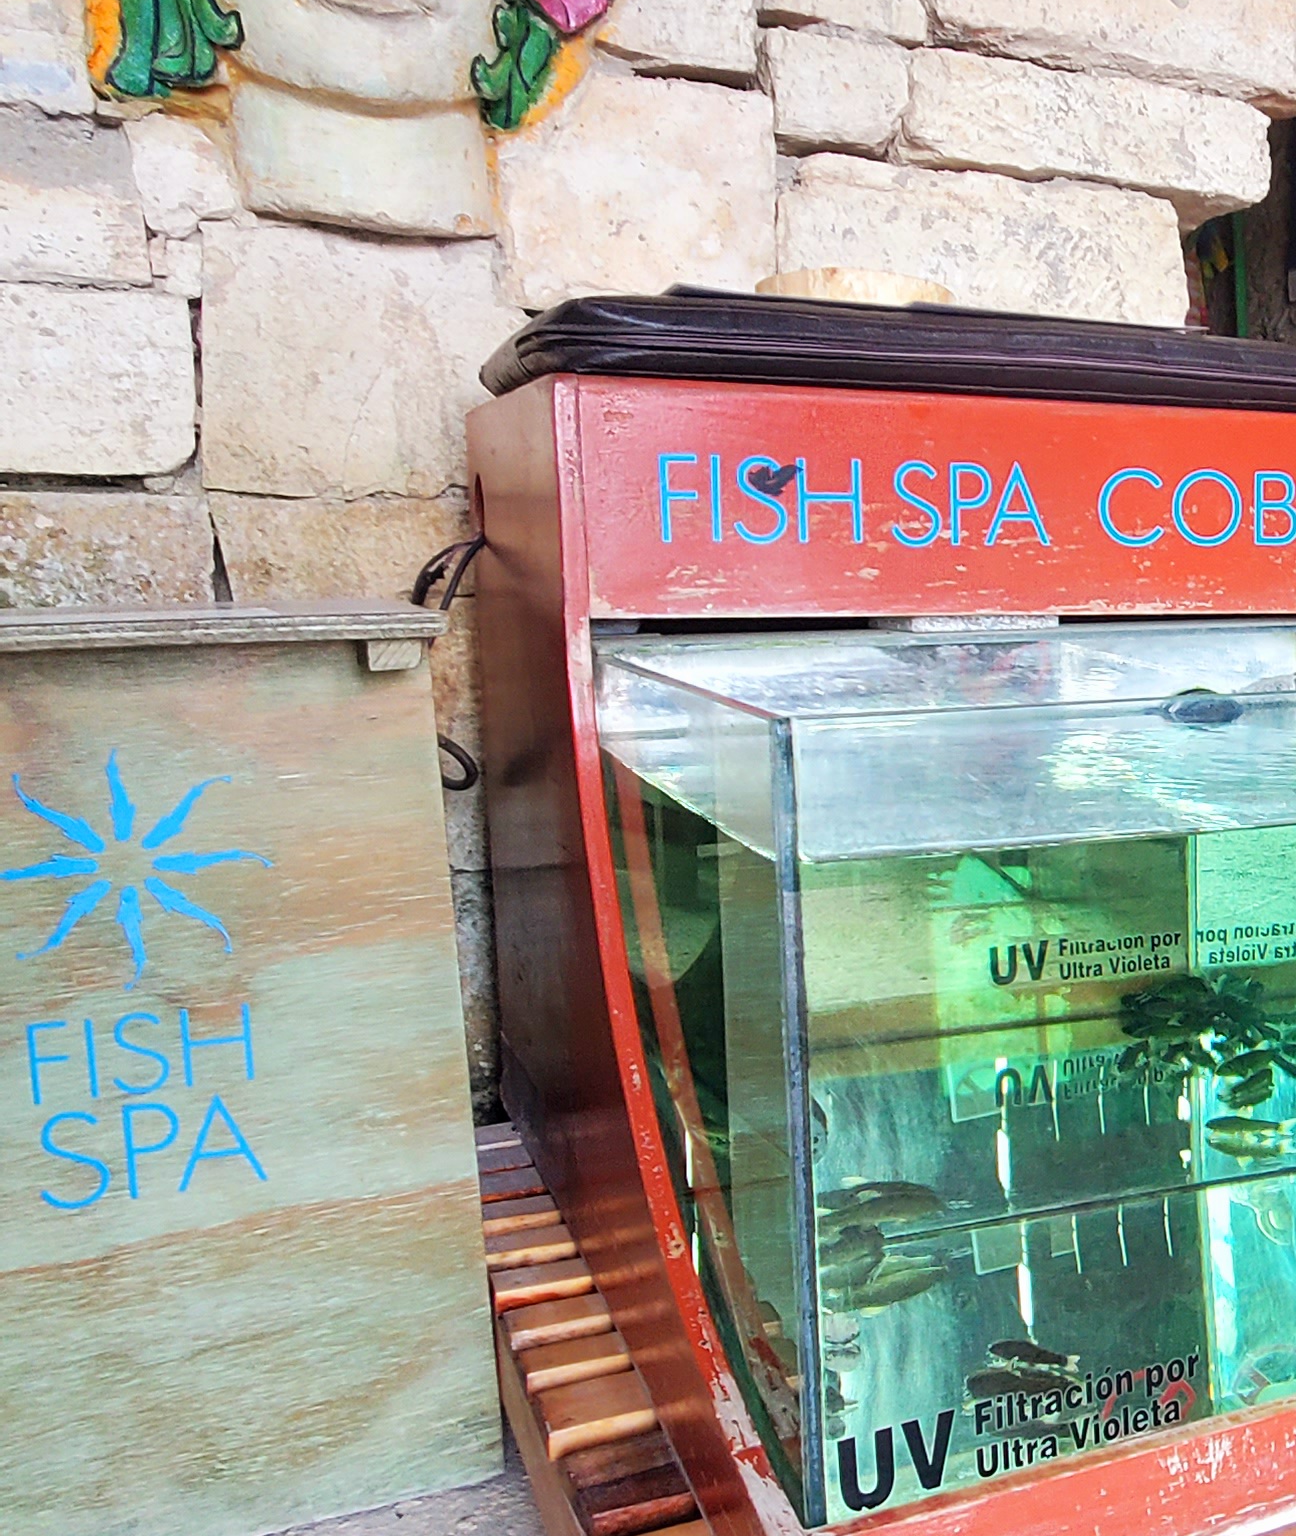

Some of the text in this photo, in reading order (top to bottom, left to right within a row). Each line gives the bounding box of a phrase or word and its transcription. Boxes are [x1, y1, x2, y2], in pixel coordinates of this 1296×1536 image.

[657, 452, 864, 545] FISH
[891, 460, 1051, 547] SPA
[989, 939, 1049, 986] UV
[1059, 954, 1171, 980] Ultra Violeta
[1151, 932, 1181, 952] por
[26, 1002, 255, 1105] FISH
[40, 1093, 268, 1210] SPA
[973, 1352, 1200, 1437] Filtración por
[836, 1409, 956, 1512] UV
[975, 1399, 1182, 1479] Ultra Violeta
